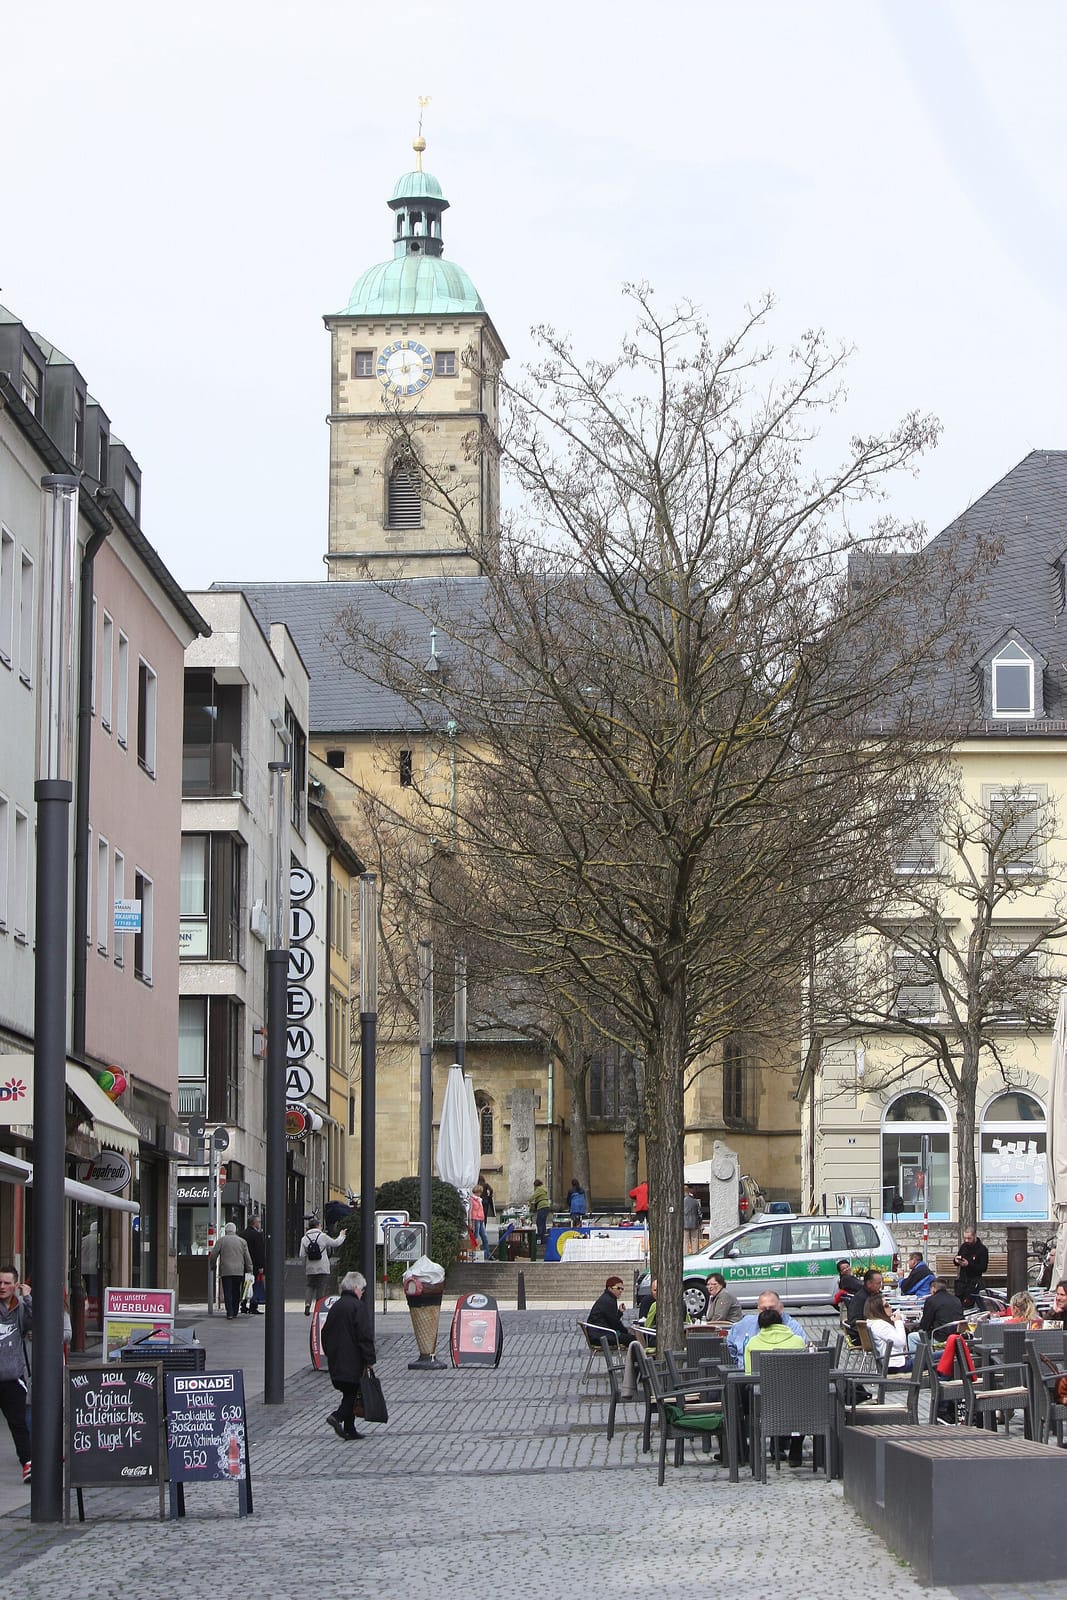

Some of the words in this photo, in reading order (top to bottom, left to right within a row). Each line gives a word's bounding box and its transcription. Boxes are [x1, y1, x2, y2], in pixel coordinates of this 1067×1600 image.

[286, 868, 309, 1095] CINEMA
[730, 1266, 771, 1277] POLIZEI
[110, 1294, 122, 1302] Aus
[112, 1302, 165, 1312] WERBUNG
[71, 1374, 89, 1388] neu
[102, 1372, 124, 1383] neu
[135, 1370, 156, 1386] neu
[177, 1378, 231, 1390] BIONADE
[85, 1388, 134, 1411] Original
[186, 1393, 215, 1407] Heute
[75, 1407, 145, 1425] italienisches
[170, 1408, 217, 1424] Tagliatelle
[221, 1404, 242, 1422] 6,30
[169, 1421, 214, 1433] Boscaiola
[73, 1431, 92, 1450] Eis
[169, 1433, 193, 1449] PIZZA
[183, 1450, 207, 1468] 5,50
